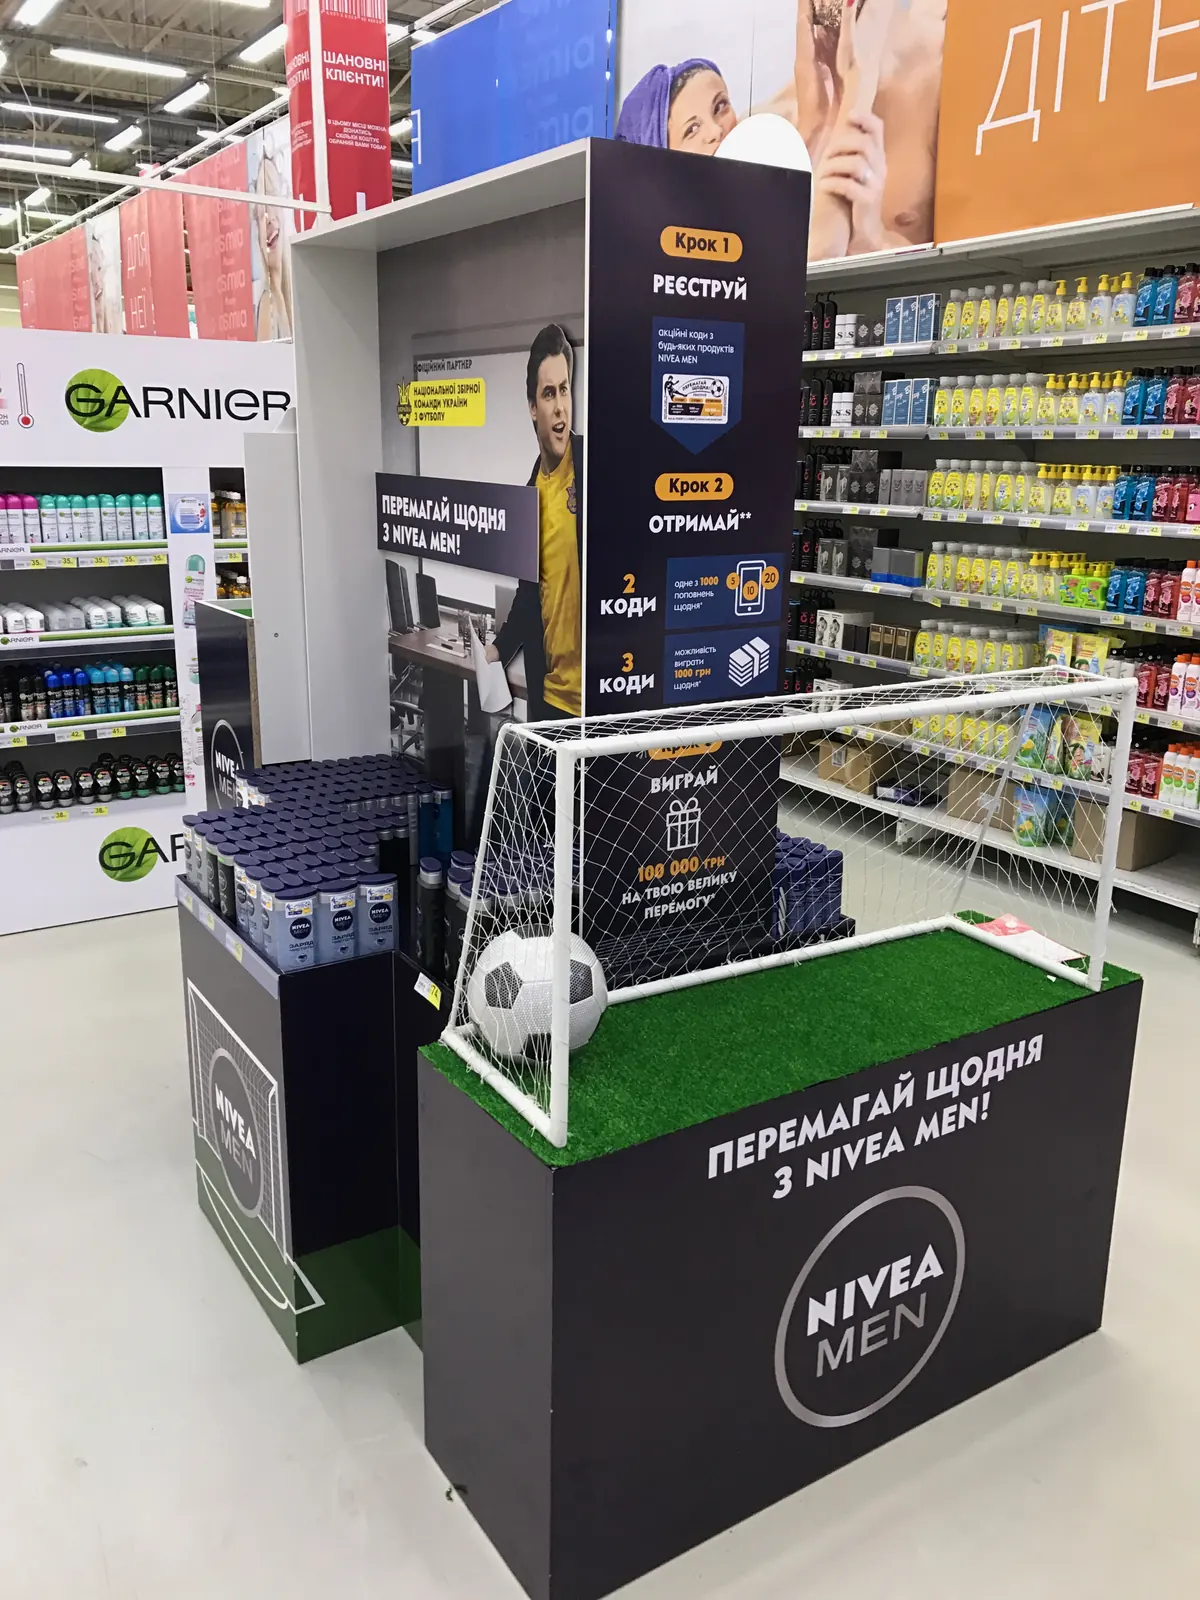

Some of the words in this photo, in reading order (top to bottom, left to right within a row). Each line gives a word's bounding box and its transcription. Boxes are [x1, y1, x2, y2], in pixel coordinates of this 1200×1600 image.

[323, 50, 386, 72] ШАНОВНІ
[325, 67, 385, 88] КЛІЄНТИ!
[675, 231, 718, 254] Крок
[723, 237, 729, 254] 1
[653, 273, 747, 301] РЕЄСТРУЙ
[658, 328, 688, 339] акційні
[689, 331, 709, 341] коди
[709, 332, 714, 340] з
[658, 341, 696, 352] будь-яких
[697, 344, 735, 355] продуктів
[446, 359, 473, 371] ПАРТНЕР
[658, 354, 681, 363] NIVEA
[681, 355, 698, 364] MEN
[413, 382, 456, 397] НАЦІОНАЛЬНОЇ
[457, 381, 481, 395] ЗБІРНОЇ
[65, 384, 291, 422] GARNIER
[414, 399, 442, 410] КОМАНДИ
[442, 396, 468, 408] УКРАЇНИ
[418, 411, 446, 422] ФУТБОЛУ
[669, 477, 709, 496] Крок
[714, 477, 724, 493] 2
[382, 495, 450, 523] ПЕРЕМАГАЙ
[453, 503, 506, 534] ЩОДНЯ
[393, 525, 427, 549] NIVEA
[430, 531, 461, 556] MEN!
[622, 573, 636, 594] 2
[674, 580, 693, 588] одне
[700, 576, 719, 586] 1000
[730, 577, 736, 585] 5
[764, 572, 776, 584] 20
[674, 590, 715, 600] поповнень
[746, 585, 754, 595] 10
[674, 646, 717, 657] можливість
[621, 652, 635, 673] 3
[674, 658, 704, 668] виграти
[674, 669, 693, 679] 1000
[695, 668, 711, 678] грн
[651, 764, 719, 794] ВИГРАЙ
[638, 863, 665, 882] 100
[670, 856, 699, 876] 000
[622, 893, 642, 906] НА
[645, 882, 684, 900] ТВОЮ
[687, 870, 738, 891] ВЕЛИКУ
[291, 923, 310, 931] NIVEA
[334, 915, 352, 923] NIVEA
[707, 1071, 915, 1179] ПЕРЕМАГАЙ
[926, 1033, 1043, 1101] ЩОДНЯ
[215, 1082, 257, 1160] NIVEA
[806, 1126, 905, 1187] NIVEA
[914, 1091, 991, 1147] MEN!
[220, 1119, 253, 1185] MEN
[806, 1244, 944, 1337] NIVEA
[816, 1292, 927, 1378] MEN
